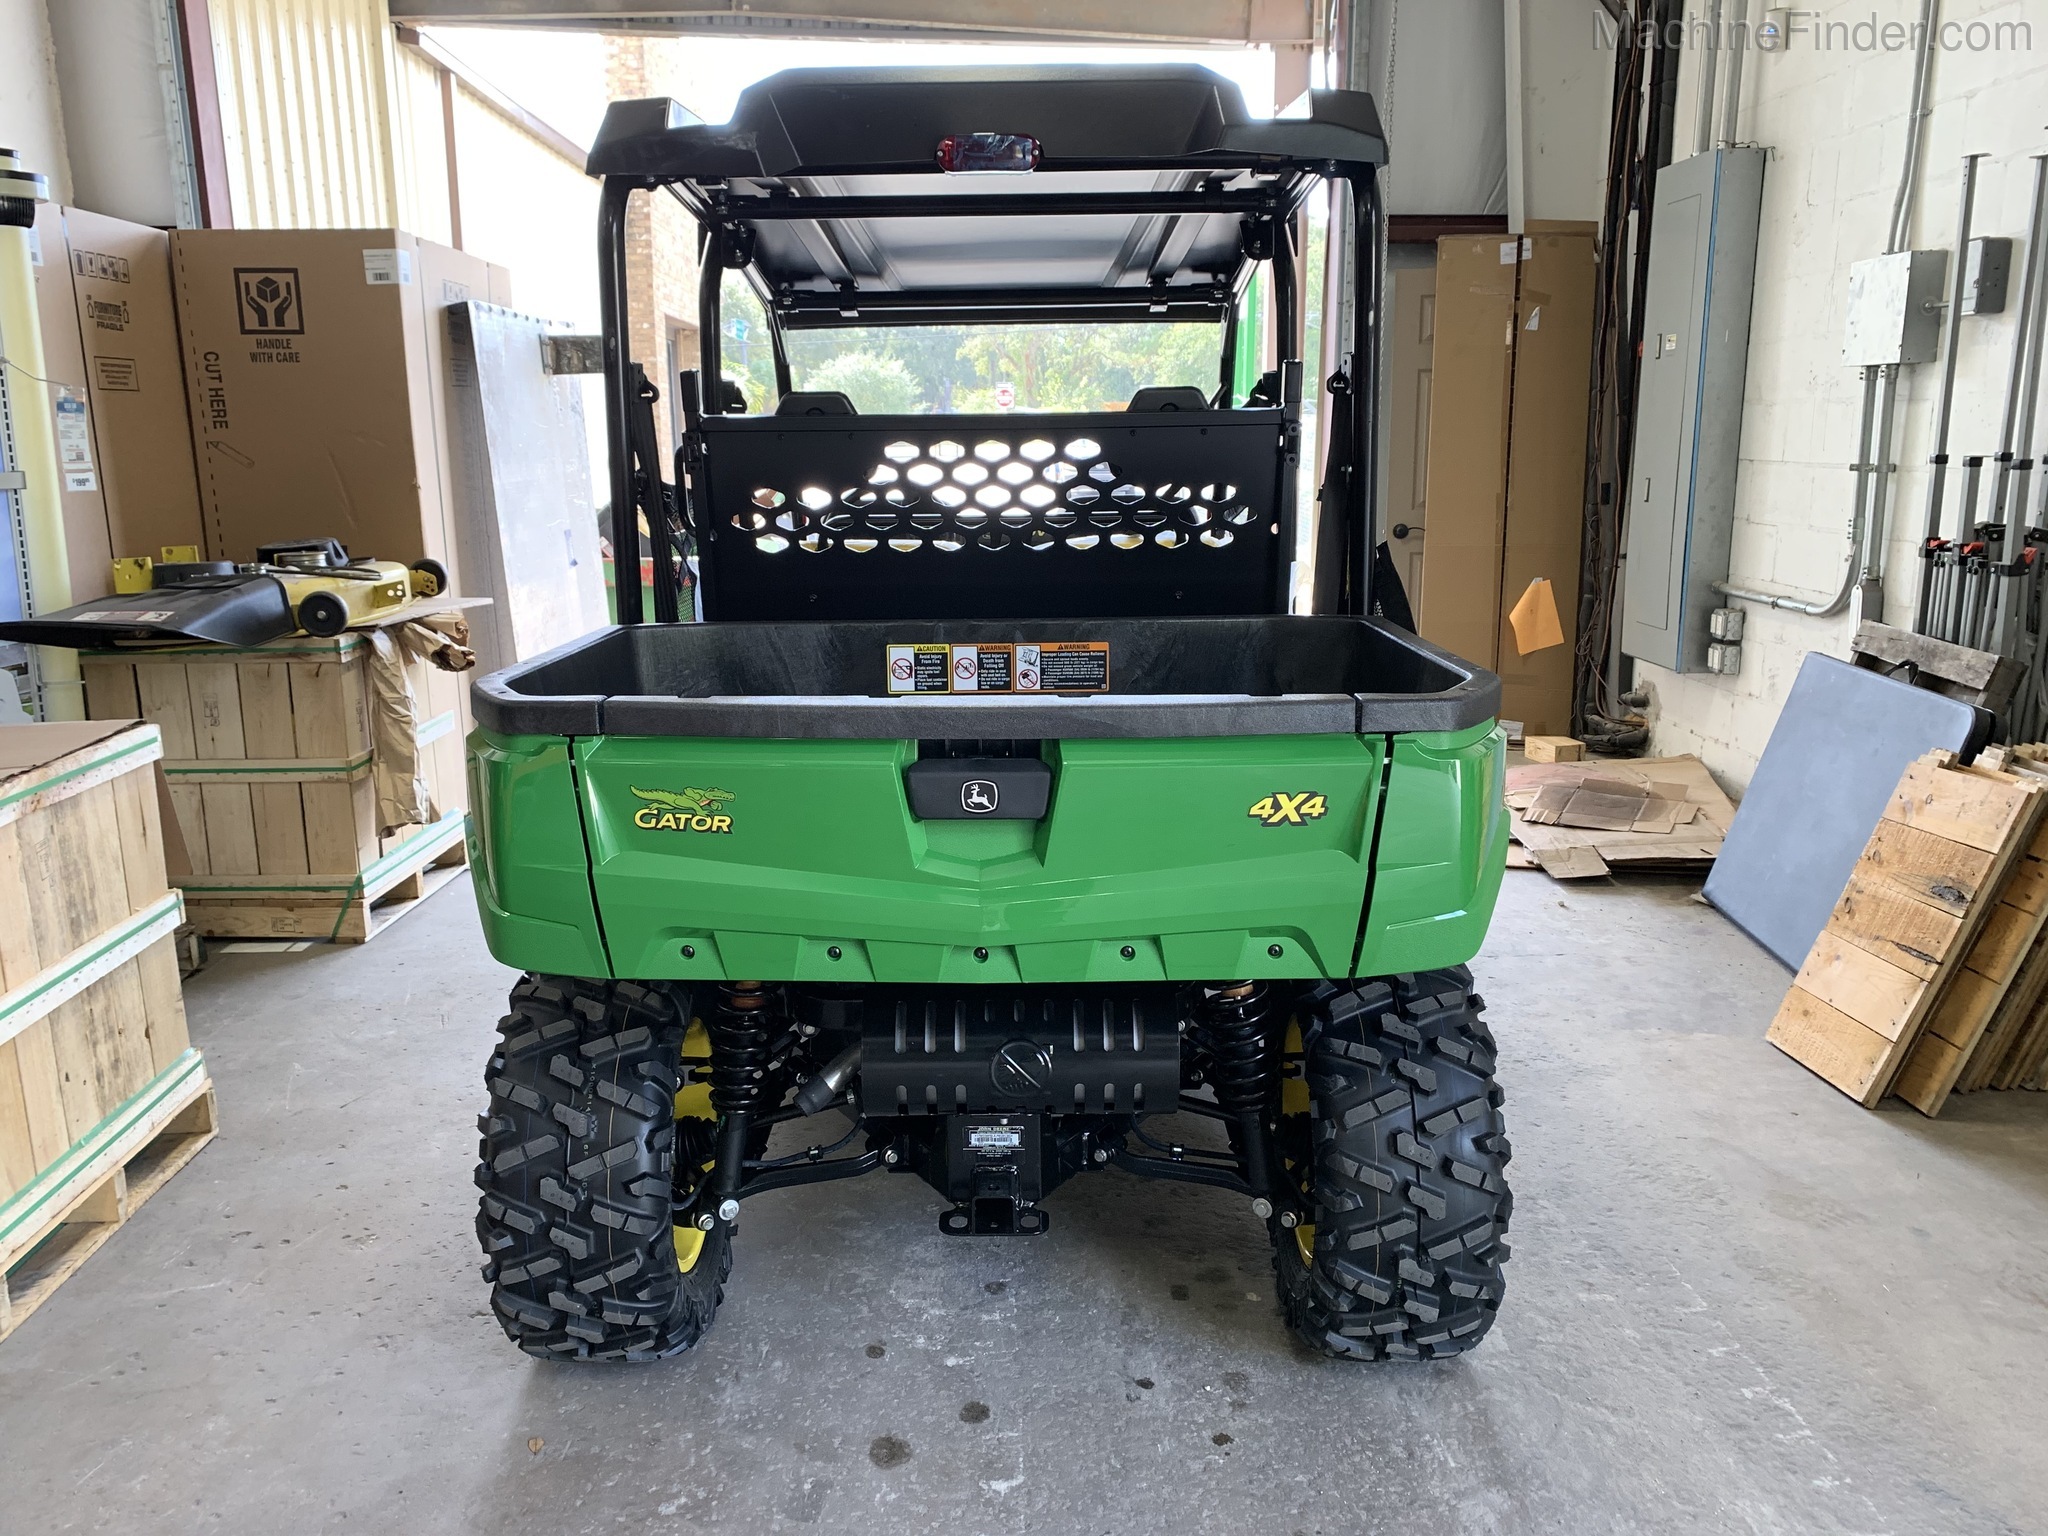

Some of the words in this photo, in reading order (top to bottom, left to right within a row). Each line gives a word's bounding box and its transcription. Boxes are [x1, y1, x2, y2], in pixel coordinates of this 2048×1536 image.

[96, 320, 125, 332] FRAGILE
[249, 351, 273, 363] WITH
[275, 351, 301, 364] CARE
[256, 338, 292, 350] HANDLE
[203, 351, 223, 384] CUT
[208, 387, 229, 430] HERE
[634, 807, 733, 835] GATOR
[1247, 791, 1329, 828] 4X4
